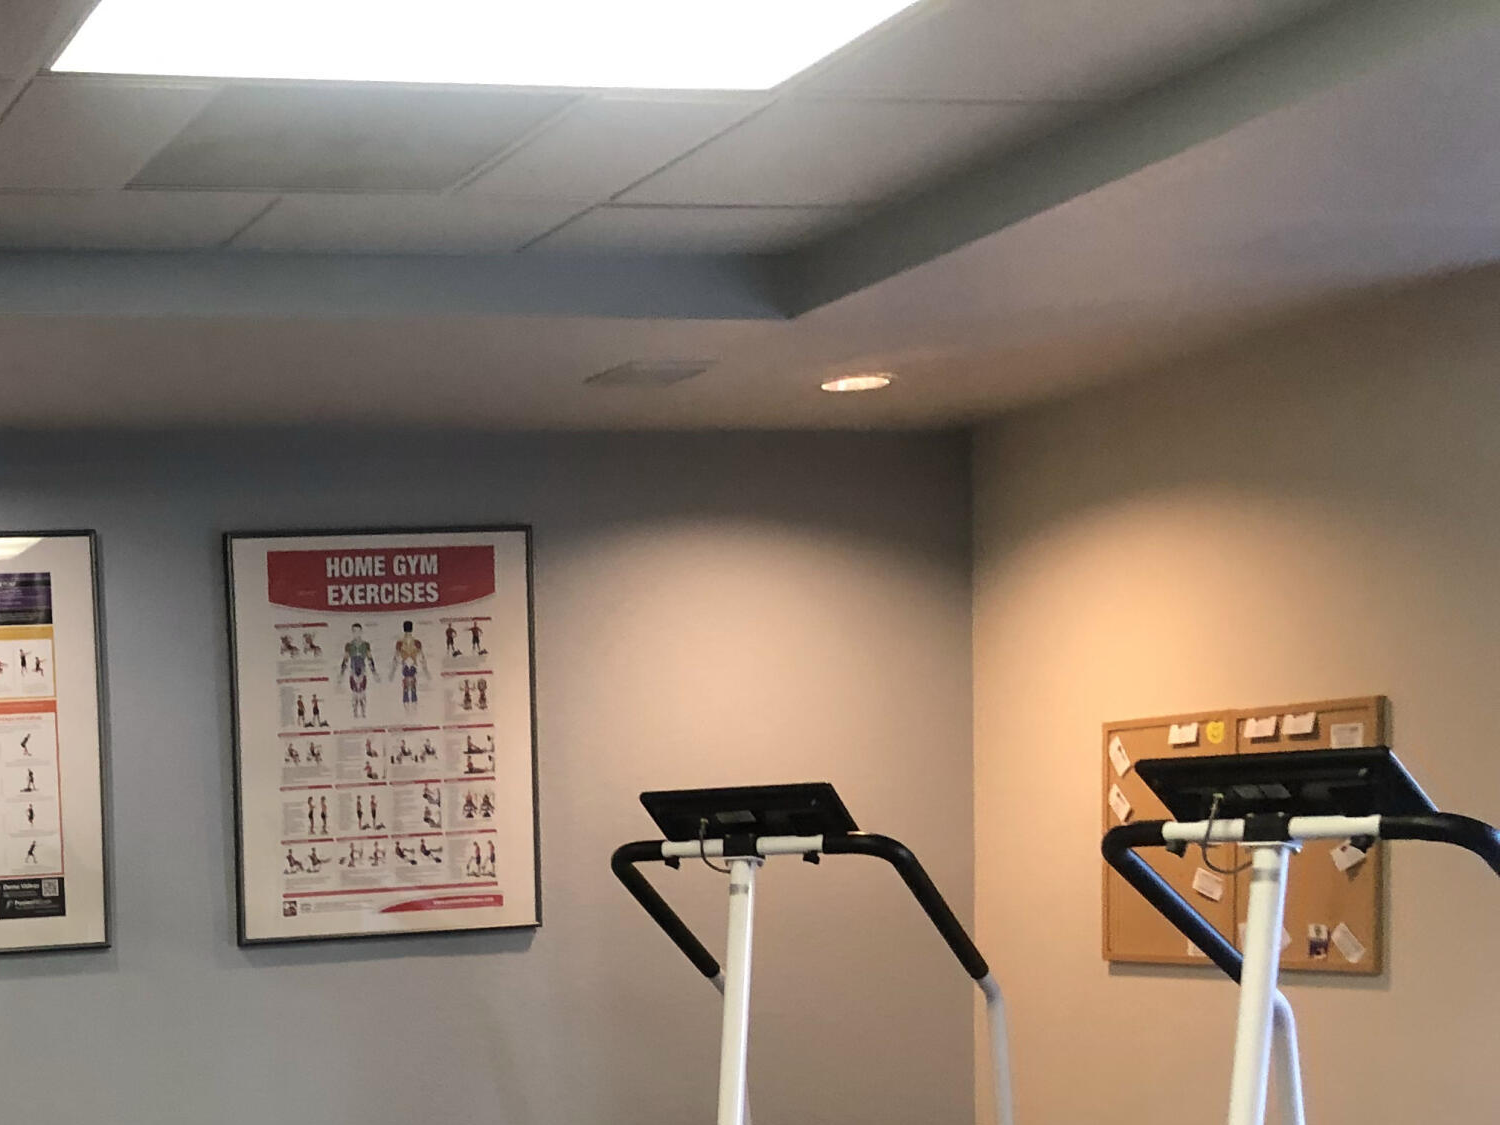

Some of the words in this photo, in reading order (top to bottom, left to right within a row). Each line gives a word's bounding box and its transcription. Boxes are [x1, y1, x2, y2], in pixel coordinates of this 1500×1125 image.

[326, 556, 386, 578] HOME
[393, 554, 438, 577] GYM
[327, 582, 440, 606] EXERCISES
